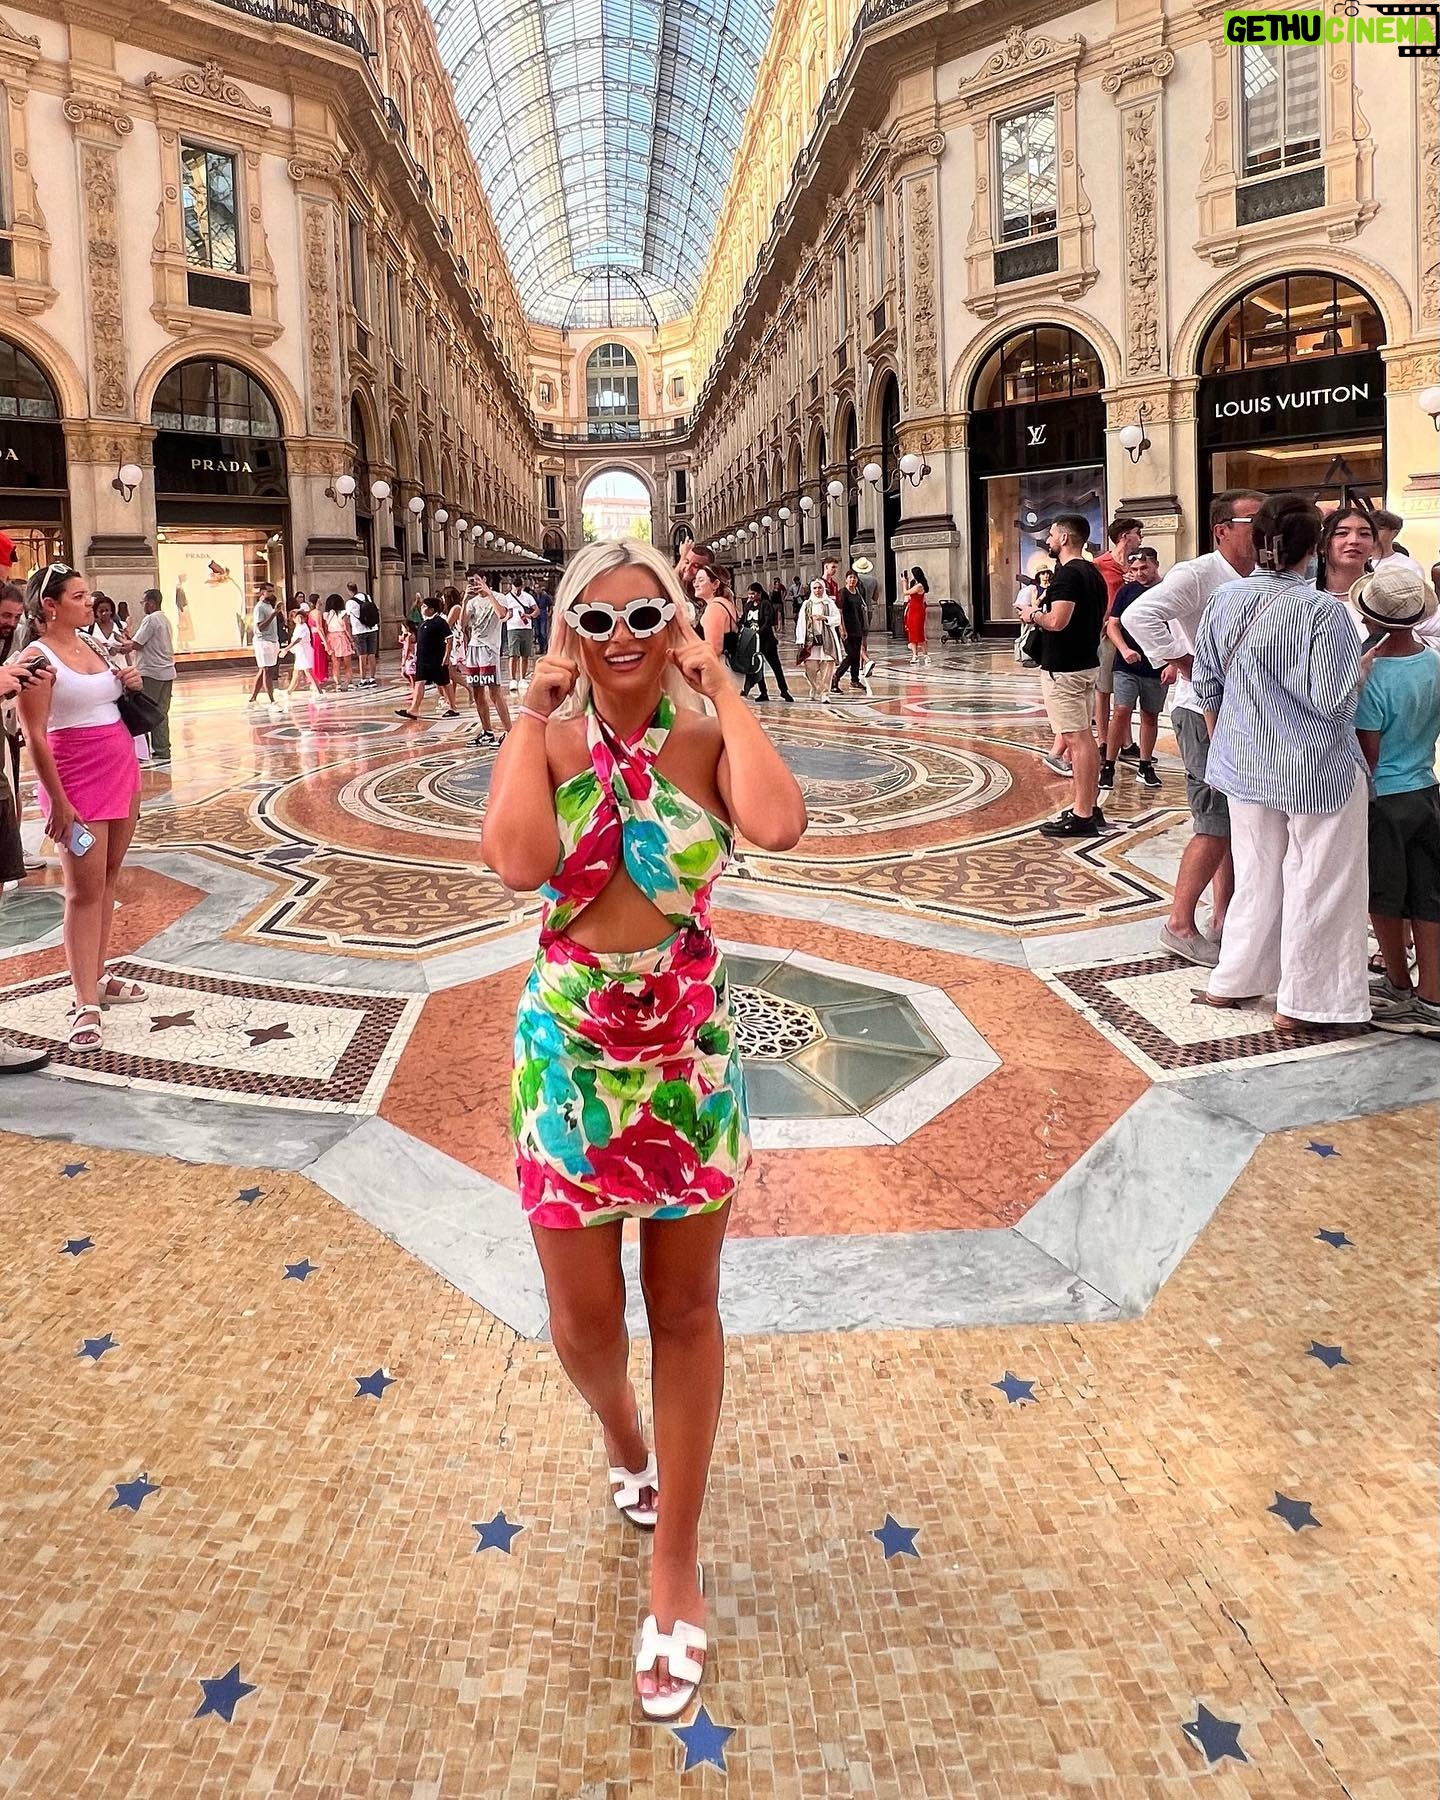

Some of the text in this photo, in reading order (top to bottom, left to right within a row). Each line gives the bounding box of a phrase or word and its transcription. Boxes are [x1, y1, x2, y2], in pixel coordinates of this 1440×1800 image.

[1215, 383, 1369, 418] LOUIS VUITTON
[191, 459, 253, 473] PRADA
